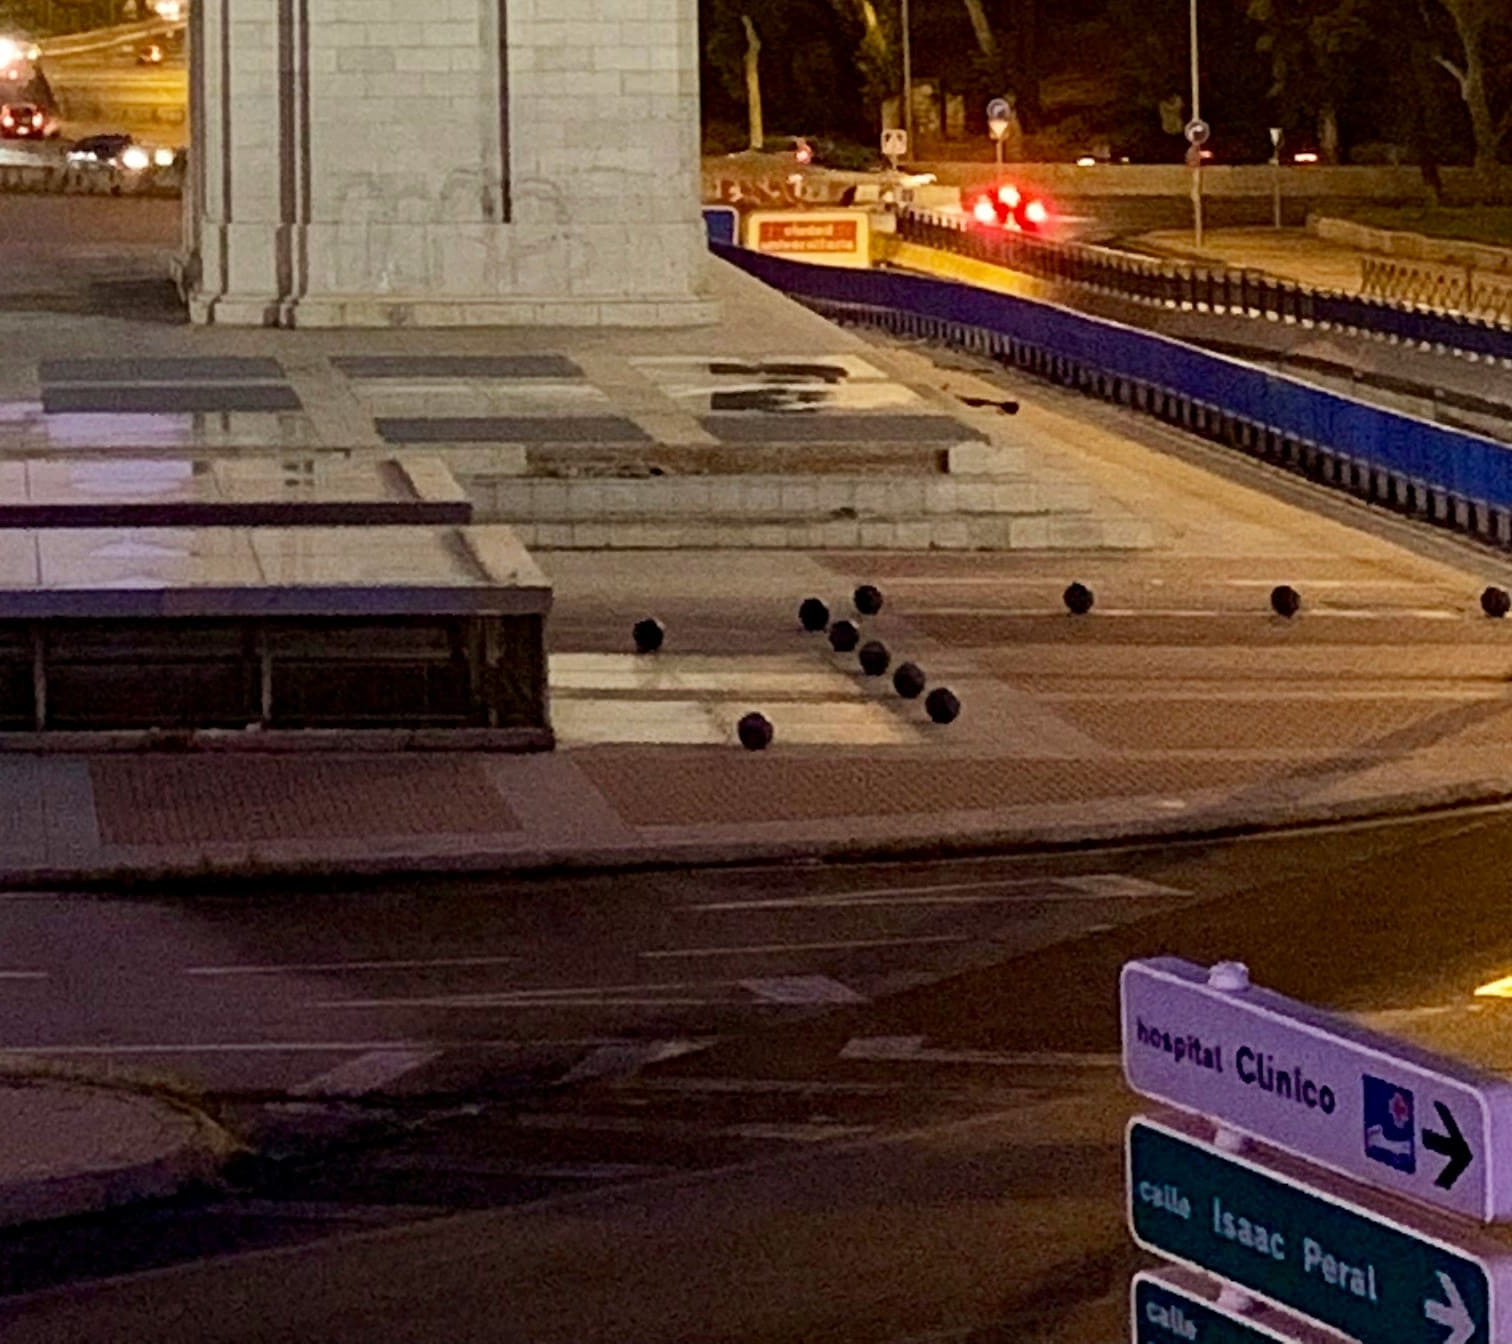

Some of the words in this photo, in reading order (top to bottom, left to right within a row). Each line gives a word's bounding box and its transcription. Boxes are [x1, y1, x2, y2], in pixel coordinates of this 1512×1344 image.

[1136, 1016, 1223, 1073] hospital
[1138, 1180, 1192, 1220] calle
[1213, 1196, 1286, 1260] Isaac
[1303, 1236, 1378, 1303] Peral
[1145, 1301, 1198, 1341] calle
